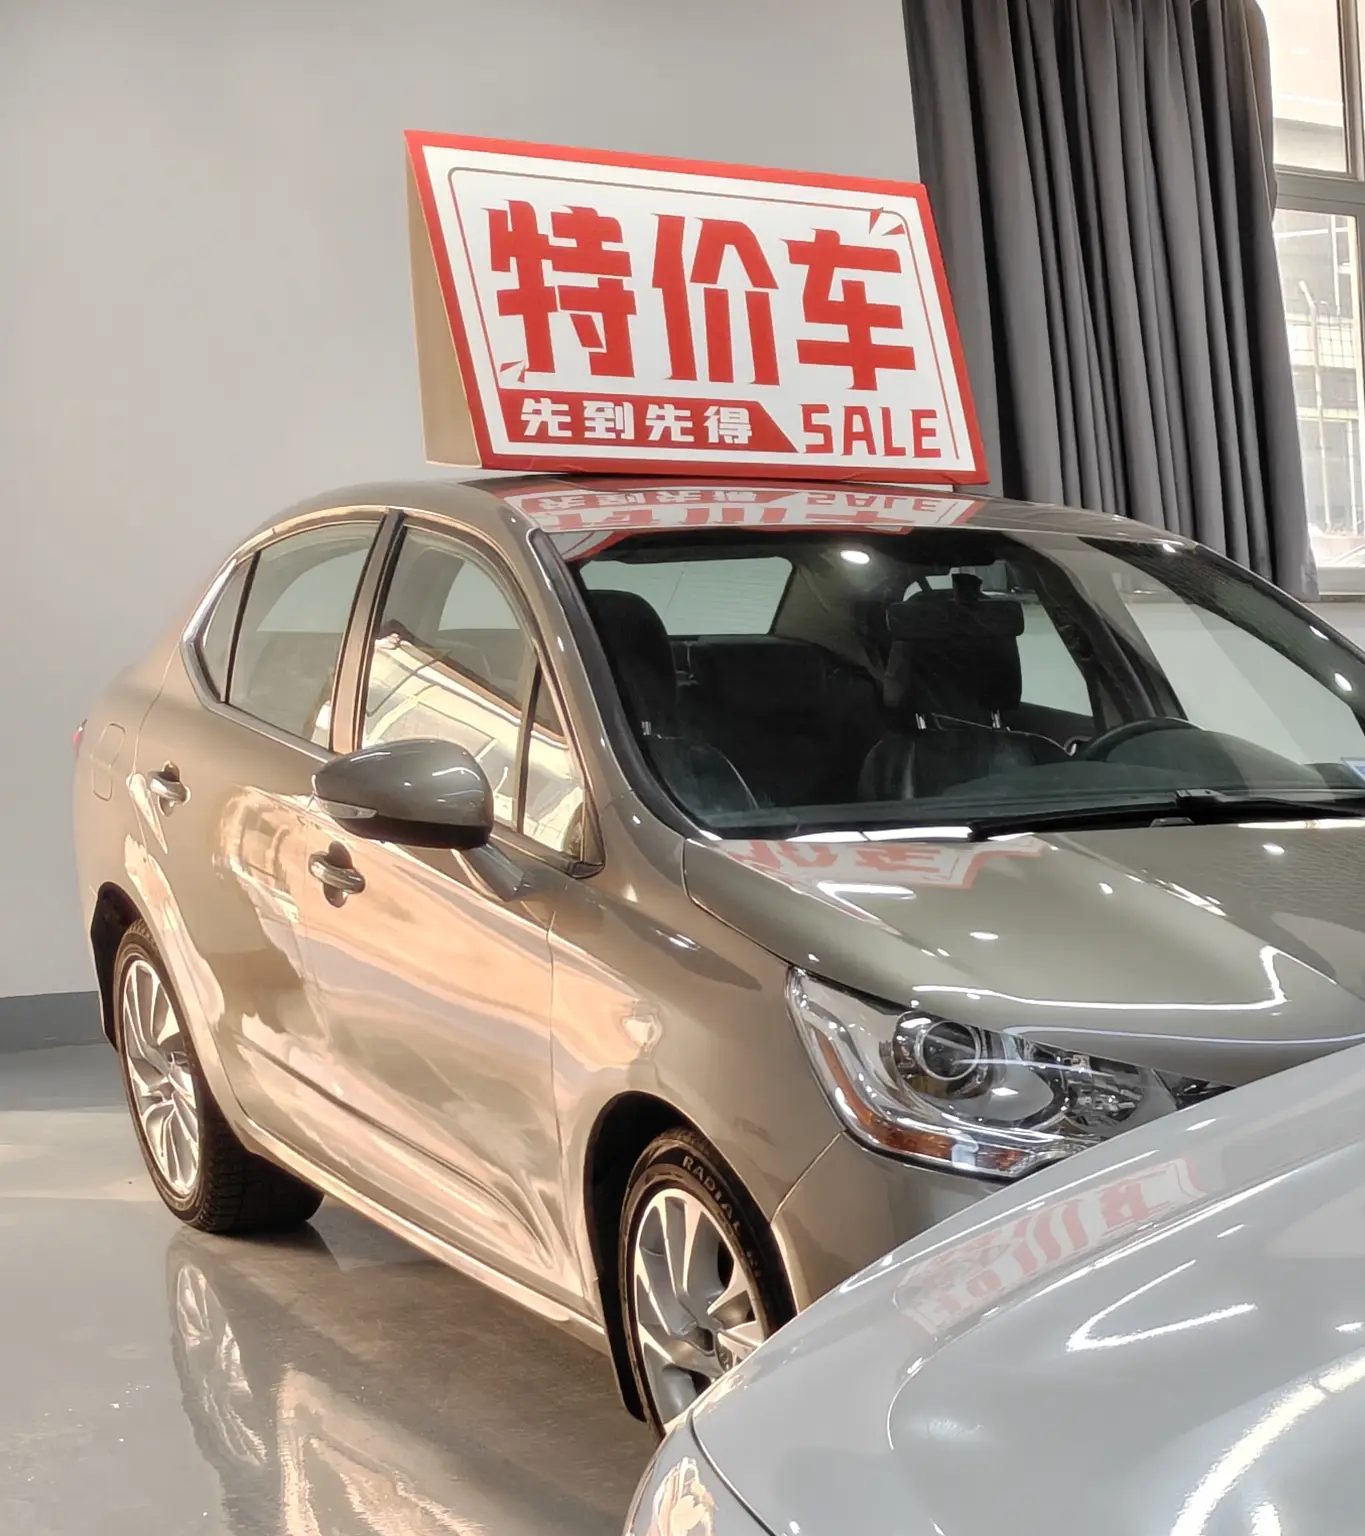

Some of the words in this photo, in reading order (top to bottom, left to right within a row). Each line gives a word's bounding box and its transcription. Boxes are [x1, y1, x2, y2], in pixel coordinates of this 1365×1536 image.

[481, 200, 916, 391] 特价车
[520, 398, 753, 446] 先到先得
[799, 402, 941, 459] SALE
